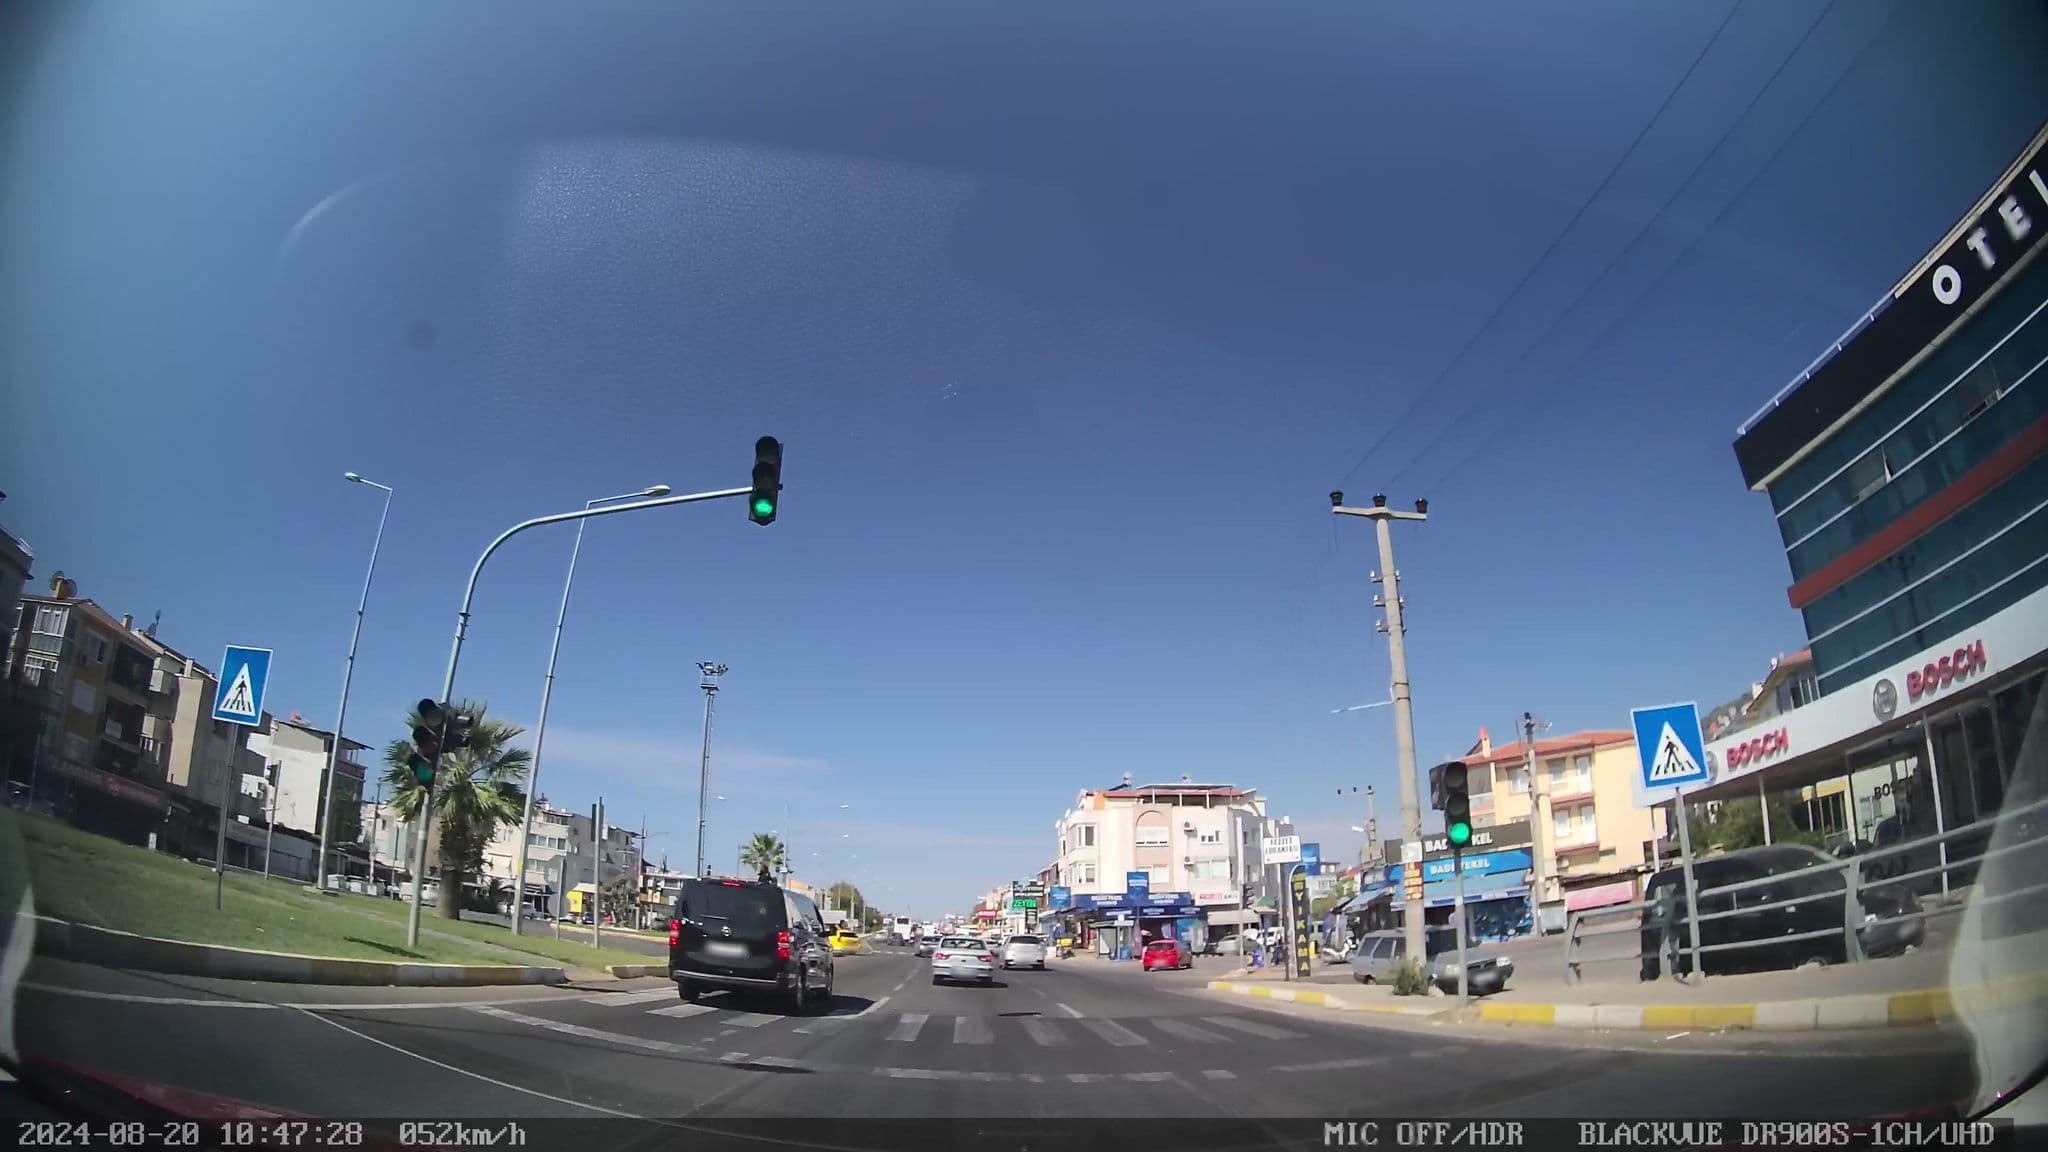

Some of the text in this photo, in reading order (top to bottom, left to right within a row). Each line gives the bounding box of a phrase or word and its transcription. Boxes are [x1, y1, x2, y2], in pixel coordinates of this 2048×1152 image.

[1907, 640, 1987, 702] BOSCH
[1727, 728, 1788, 769] BOSCH
[1471, 832, 1493, 846] KEL
